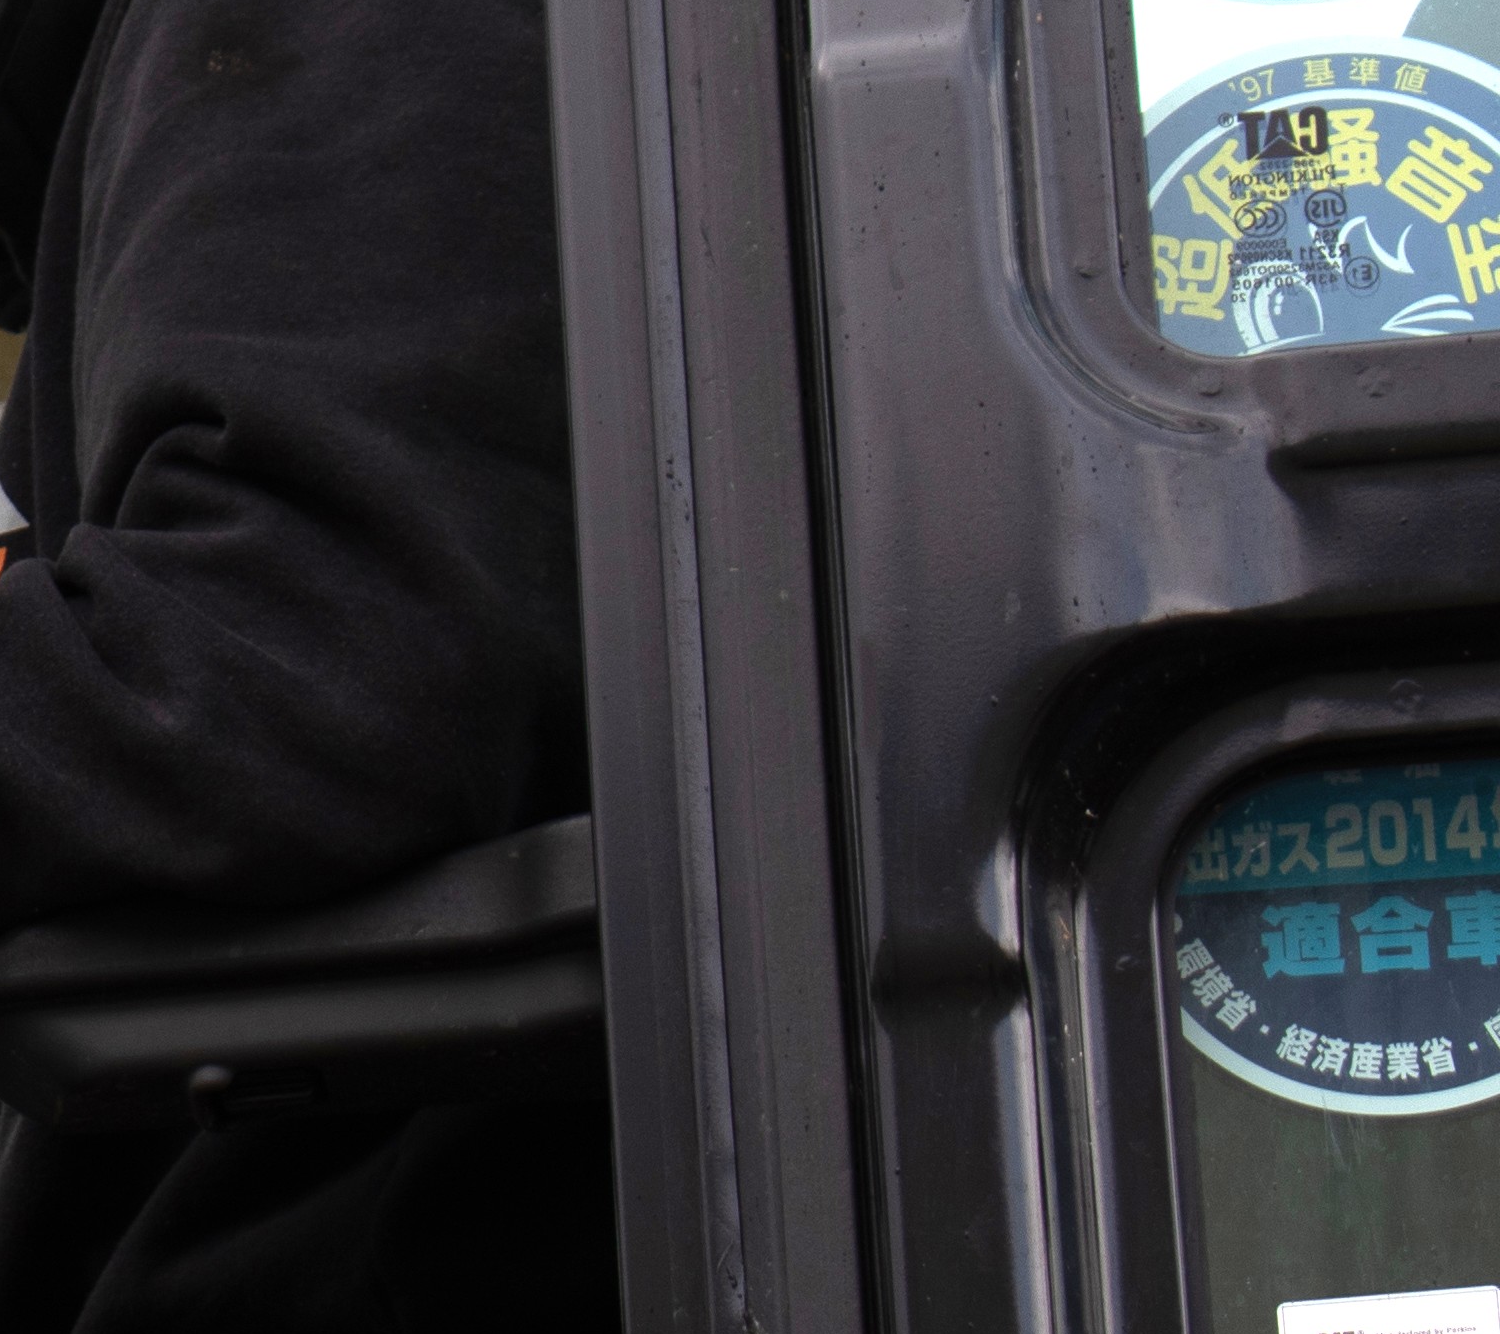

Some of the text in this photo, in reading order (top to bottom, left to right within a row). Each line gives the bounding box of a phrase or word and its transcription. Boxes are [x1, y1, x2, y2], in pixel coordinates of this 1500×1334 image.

[1303, 56, 1430, 95] 基準値
[1185, 785, 1500, 882] 出ガス2014
